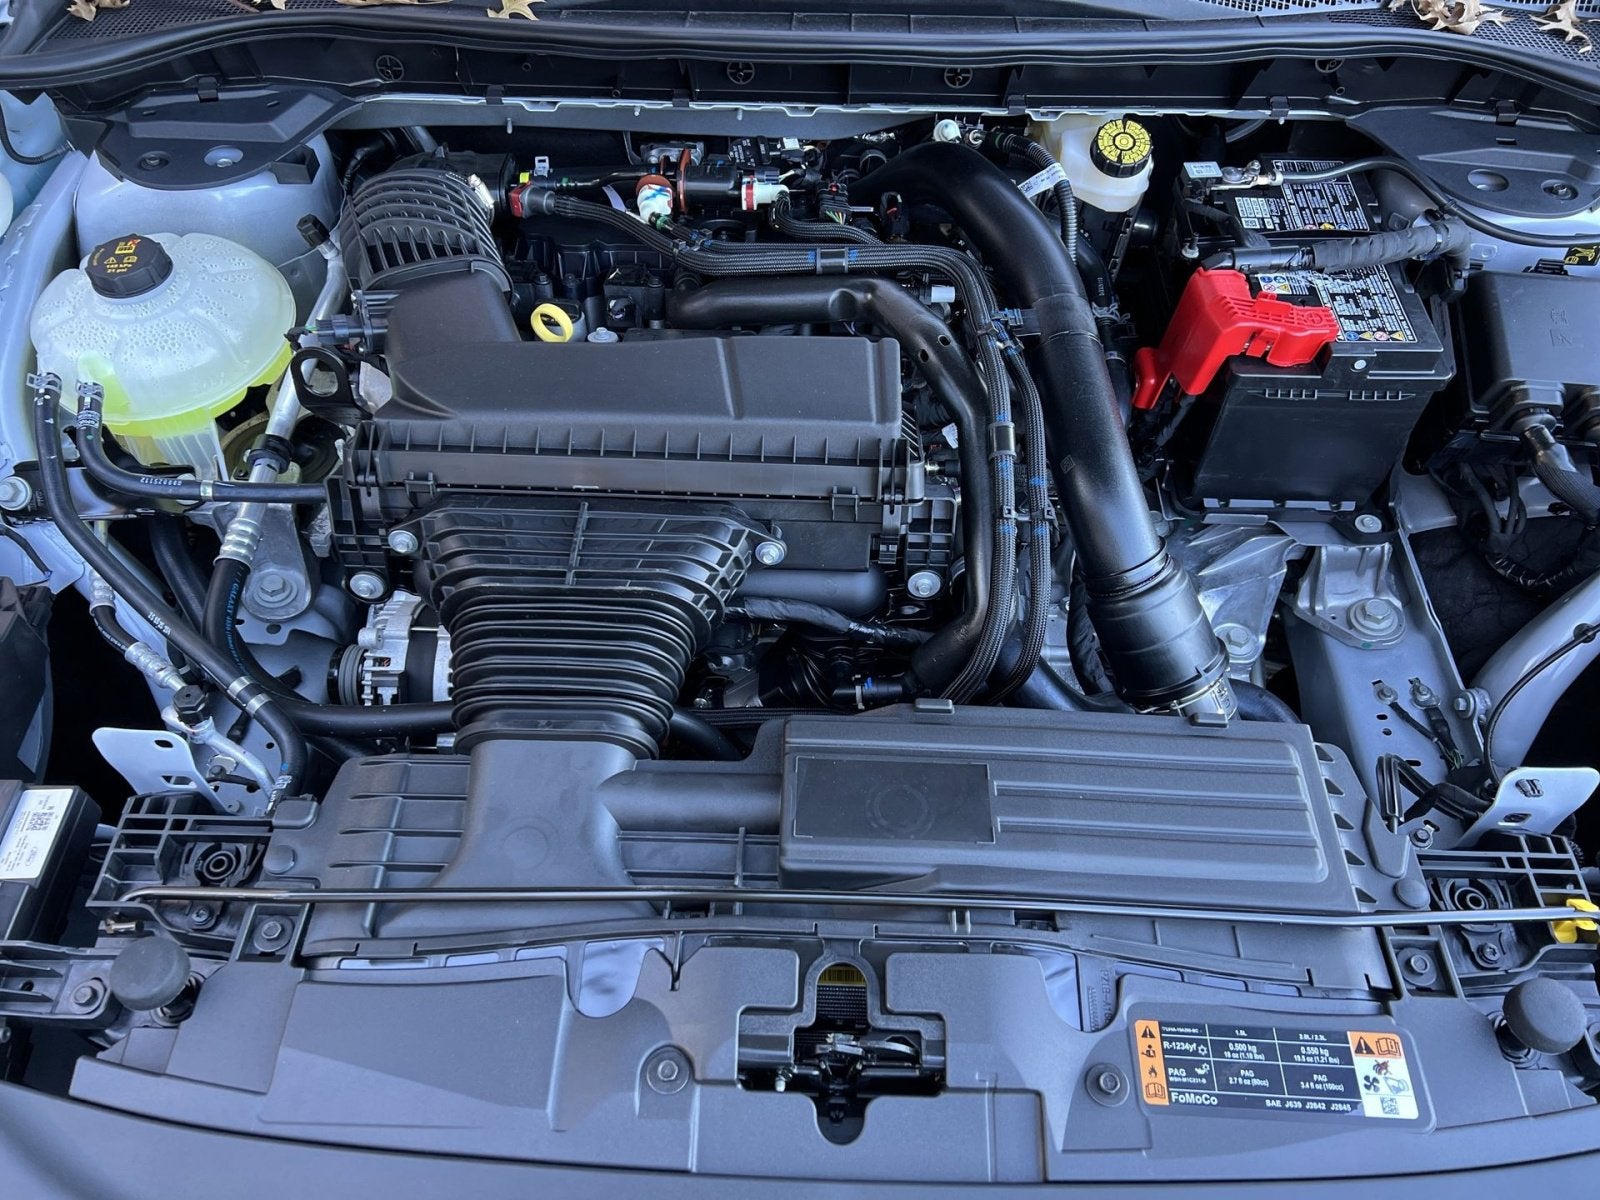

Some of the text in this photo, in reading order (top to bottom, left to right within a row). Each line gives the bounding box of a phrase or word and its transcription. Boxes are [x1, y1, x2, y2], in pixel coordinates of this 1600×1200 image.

[1162, 1040, 1197, 1053] R-1234yf
[1228, 1042, 1258, 1054] 0.500 kg
[1319, 1048, 1330, 1058] kg
[1168, 1067, 1187, 1077] PAG
[1240, 1069, 1255, 1078] PAG
[1228, 1076, 1238, 1085] 2.7
[1312, 1073, 1329, 1082] PAG
[1171, 1091, 1219, 1105] FoMoCo
[1264, 1099, 1282, 1108] SAE
